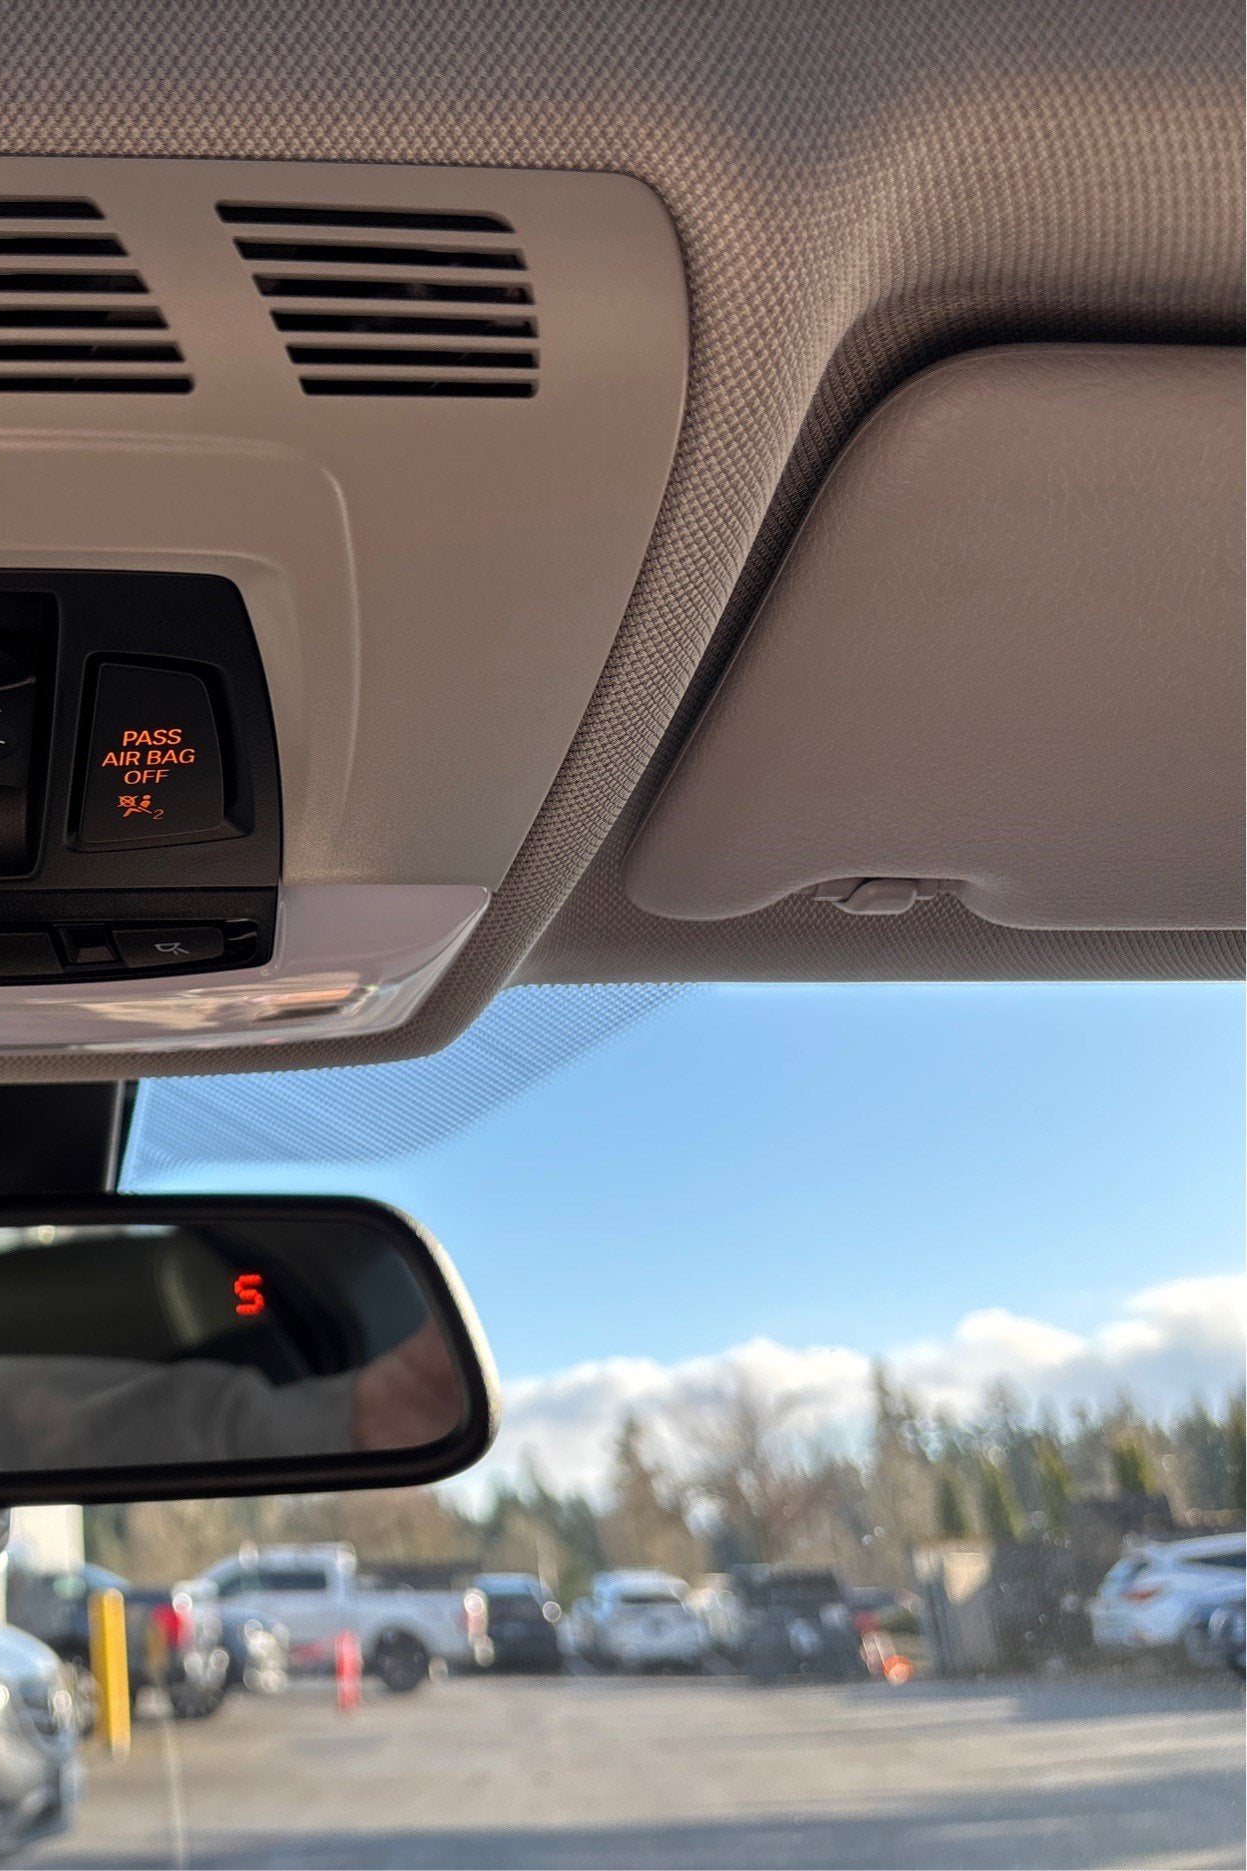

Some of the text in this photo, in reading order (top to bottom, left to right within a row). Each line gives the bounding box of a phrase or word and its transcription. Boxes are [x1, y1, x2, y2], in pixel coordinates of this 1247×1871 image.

[122, 728, 183, 747] PASS
[101, 748, 196, 767] AIR BAG
[124, 769, 170, 785] OFF
[152, 809, 165, 820] 2
